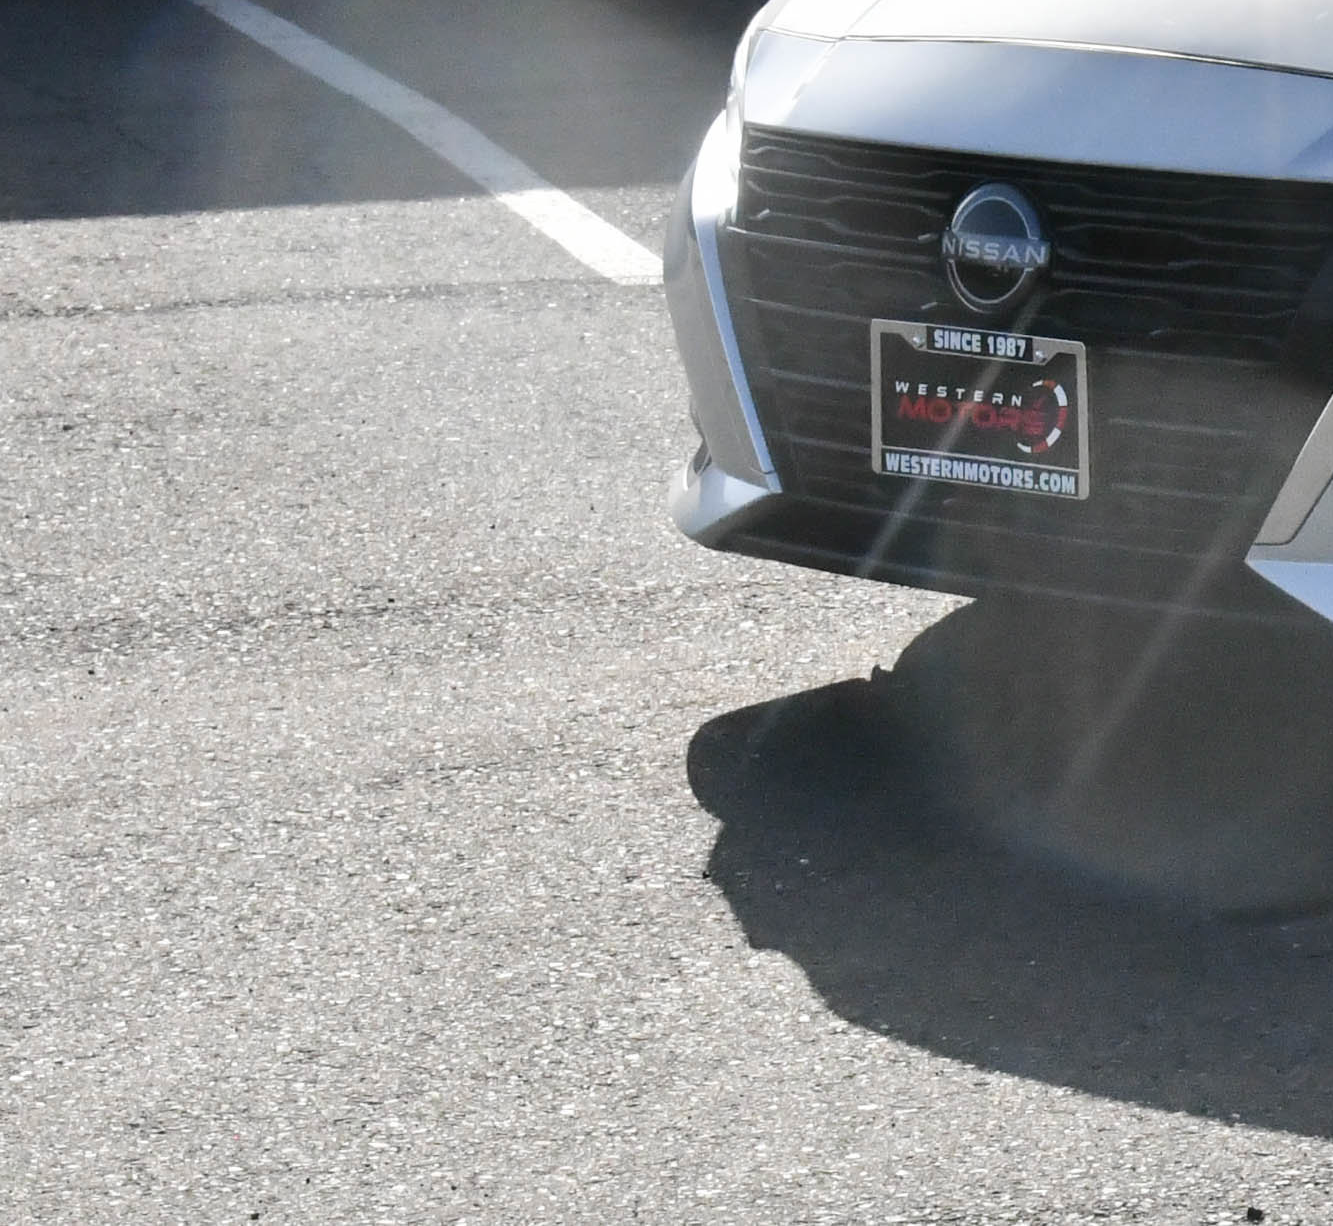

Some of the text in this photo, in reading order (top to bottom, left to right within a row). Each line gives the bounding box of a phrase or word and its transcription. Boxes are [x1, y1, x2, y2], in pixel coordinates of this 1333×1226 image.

[942, 235, 1049, 265] NISSAN
[933, 329, 1027, 359] SINCE 1987
[895, 380, 1023, 407] WESTERN
[897, 394, 1046, 436] MOTORS
[885, 452, 1077, 495] WESTERNMOTORS.COM
